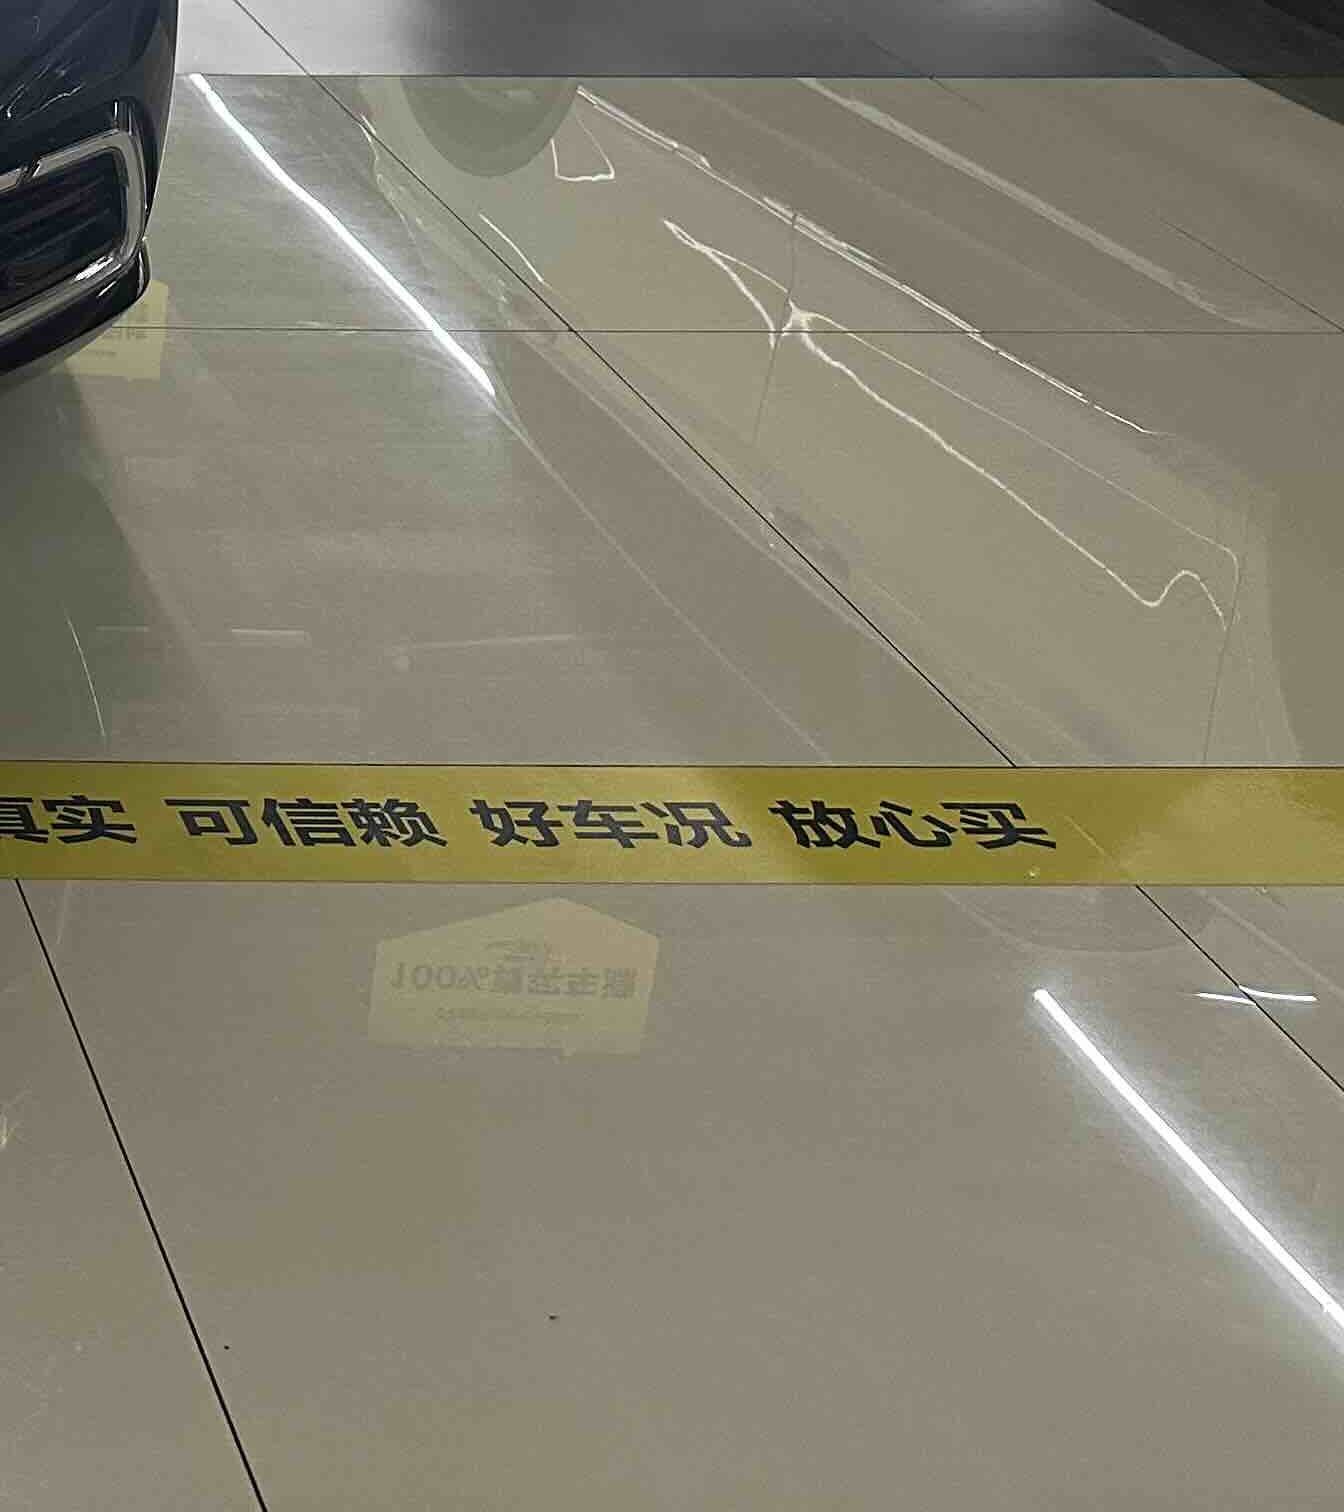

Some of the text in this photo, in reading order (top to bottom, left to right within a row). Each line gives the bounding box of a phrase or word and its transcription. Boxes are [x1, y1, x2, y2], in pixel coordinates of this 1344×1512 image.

[164, 798, 448, 847] 可信赖
[469, 800, 752, 849] 好车况
[768, 800, 1056, 849] 放心买
